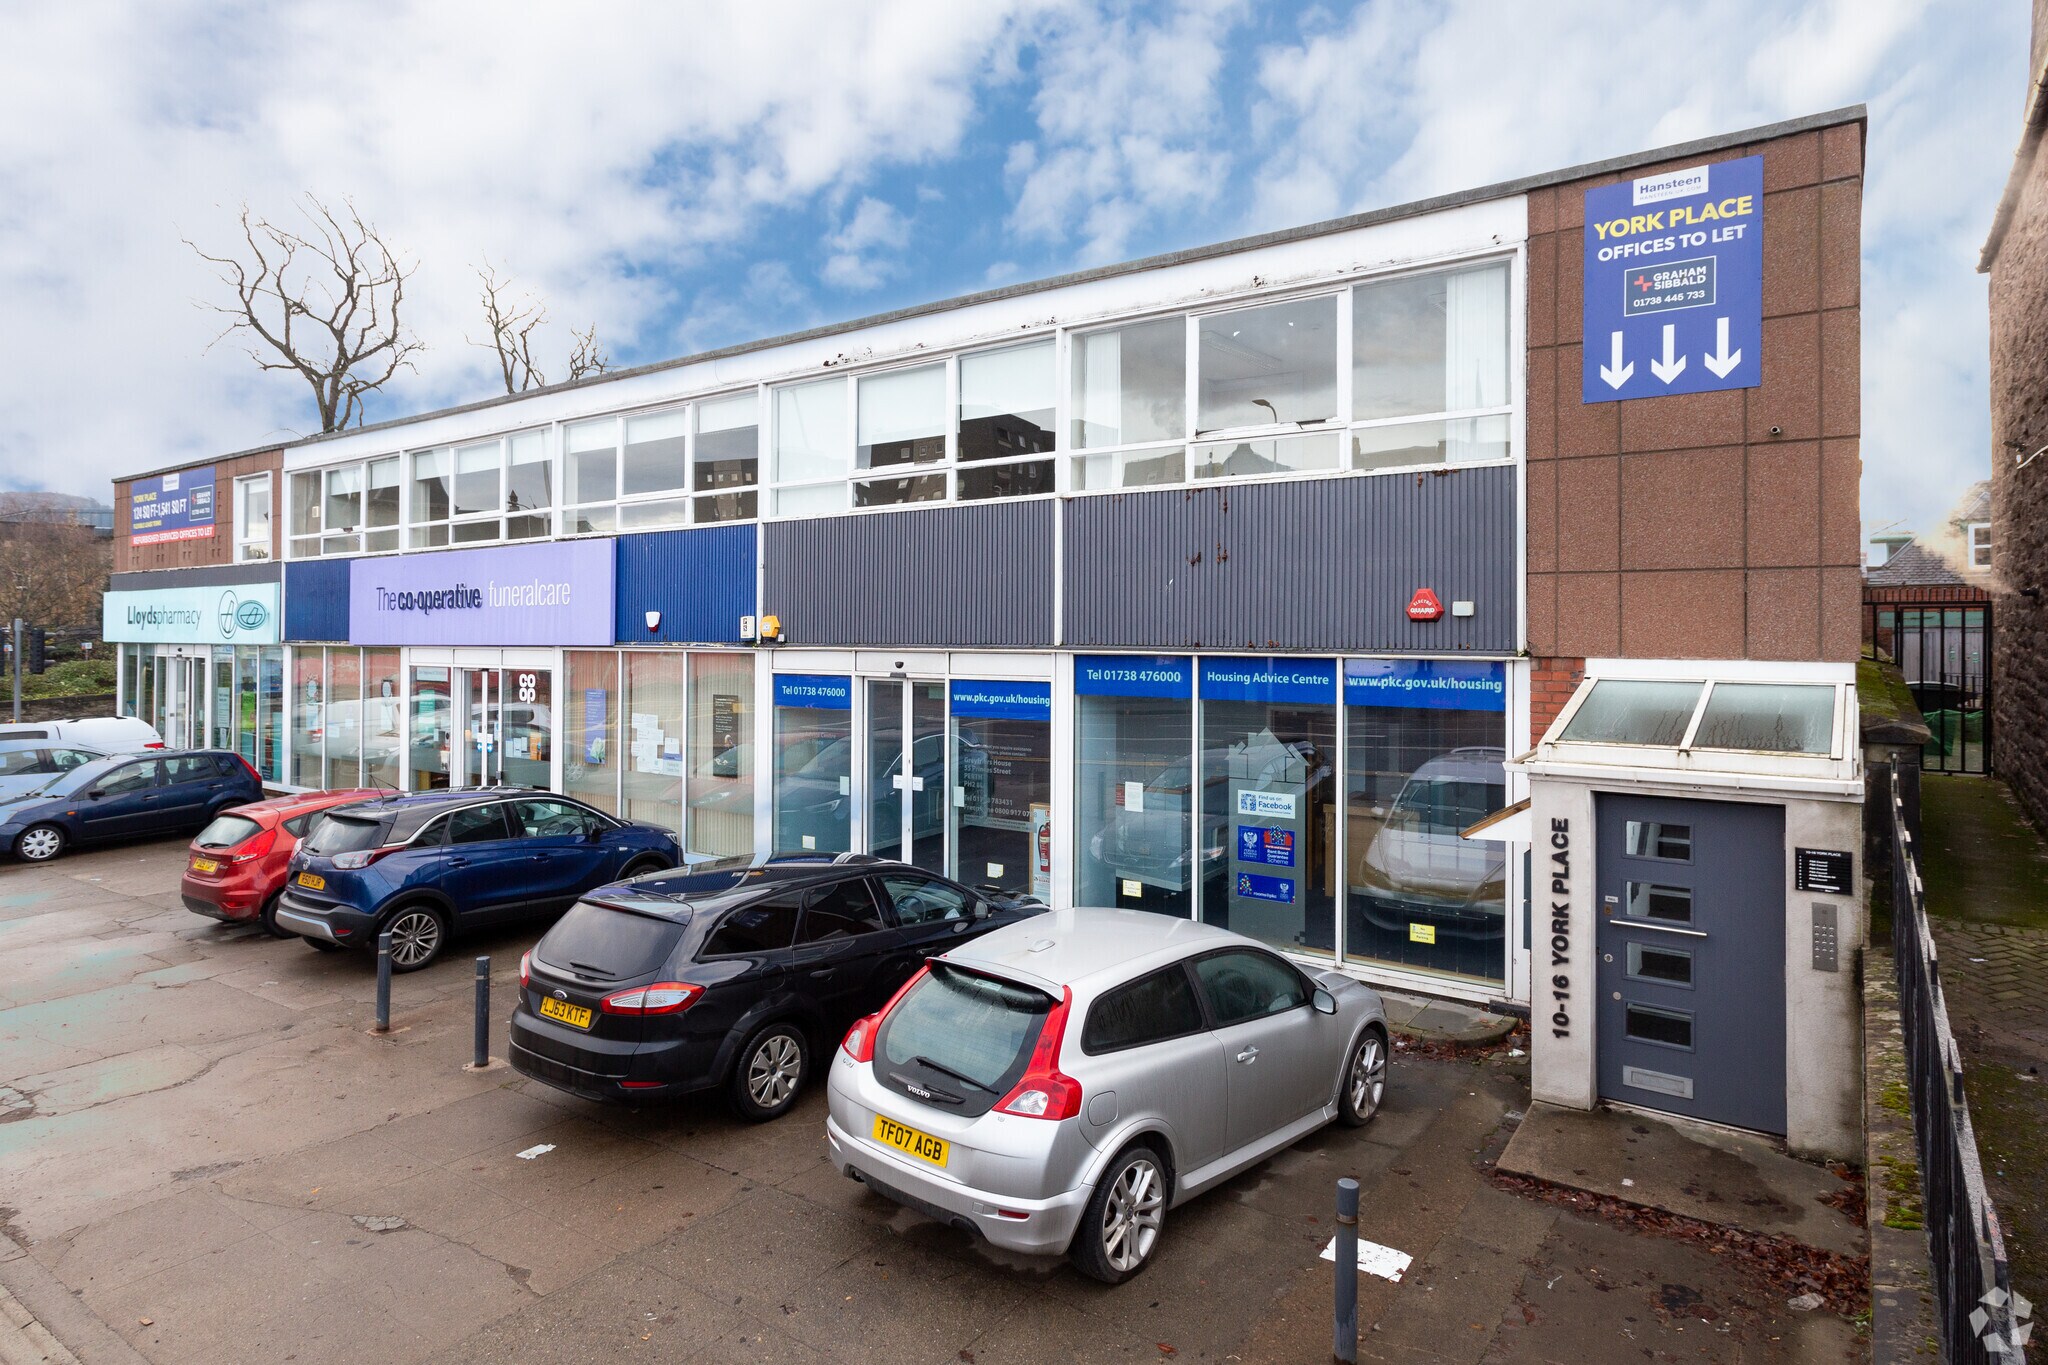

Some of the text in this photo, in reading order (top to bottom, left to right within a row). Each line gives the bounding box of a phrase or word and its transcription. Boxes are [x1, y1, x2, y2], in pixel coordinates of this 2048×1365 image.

[1640, 176, 1701, 194] Hansteen
[1594, 195, 1753, 240] YORK PLACE
[1597, 224, 1747, 262] OFFICES TO LET
[1653, 266, 1706, 282] GRAHAM
[1654, 275, 1706, 290] SIBBALD
[1634, 296, 1662, 307] 01738
[1686, 290, 1705, 300] 733
[171, 500, 180, 514] SQ
[180, 498, 187, 512] FT
[198, 528, 204, 536] TO
[205, 526, 213, 536] LET
[376, 587, 396, 610] The
[488, 578, 570, 608] funeralcare
[1413, 598, 1432, 606] ELECTRO
[128, 605, 202, 630] Lloydspharmacy
[1086, 669, 1181, 682] Tel 01738 476000
[1207, 672, 1329, 685] Housing Advice Centre
[782, 686, 846, 696] Tel 01738 476000
[1349, 676, 1502, 693] www.pkc.gov.uk/housing
[954, 693, 1050, 707] www.pkc.gov.uk/housing
[992, 798, 1013, 806] 783431
[1258, 801, 1292, 810] Facebook
[1551, 817, 1569, 1039] 10-16 YORK PLACE
[544, 998, 587, 1022] LJ63 KTF
[907, 1085, 930, 1098] VOLVO
[881, 1120, 942, 1160] TF07 AGB
